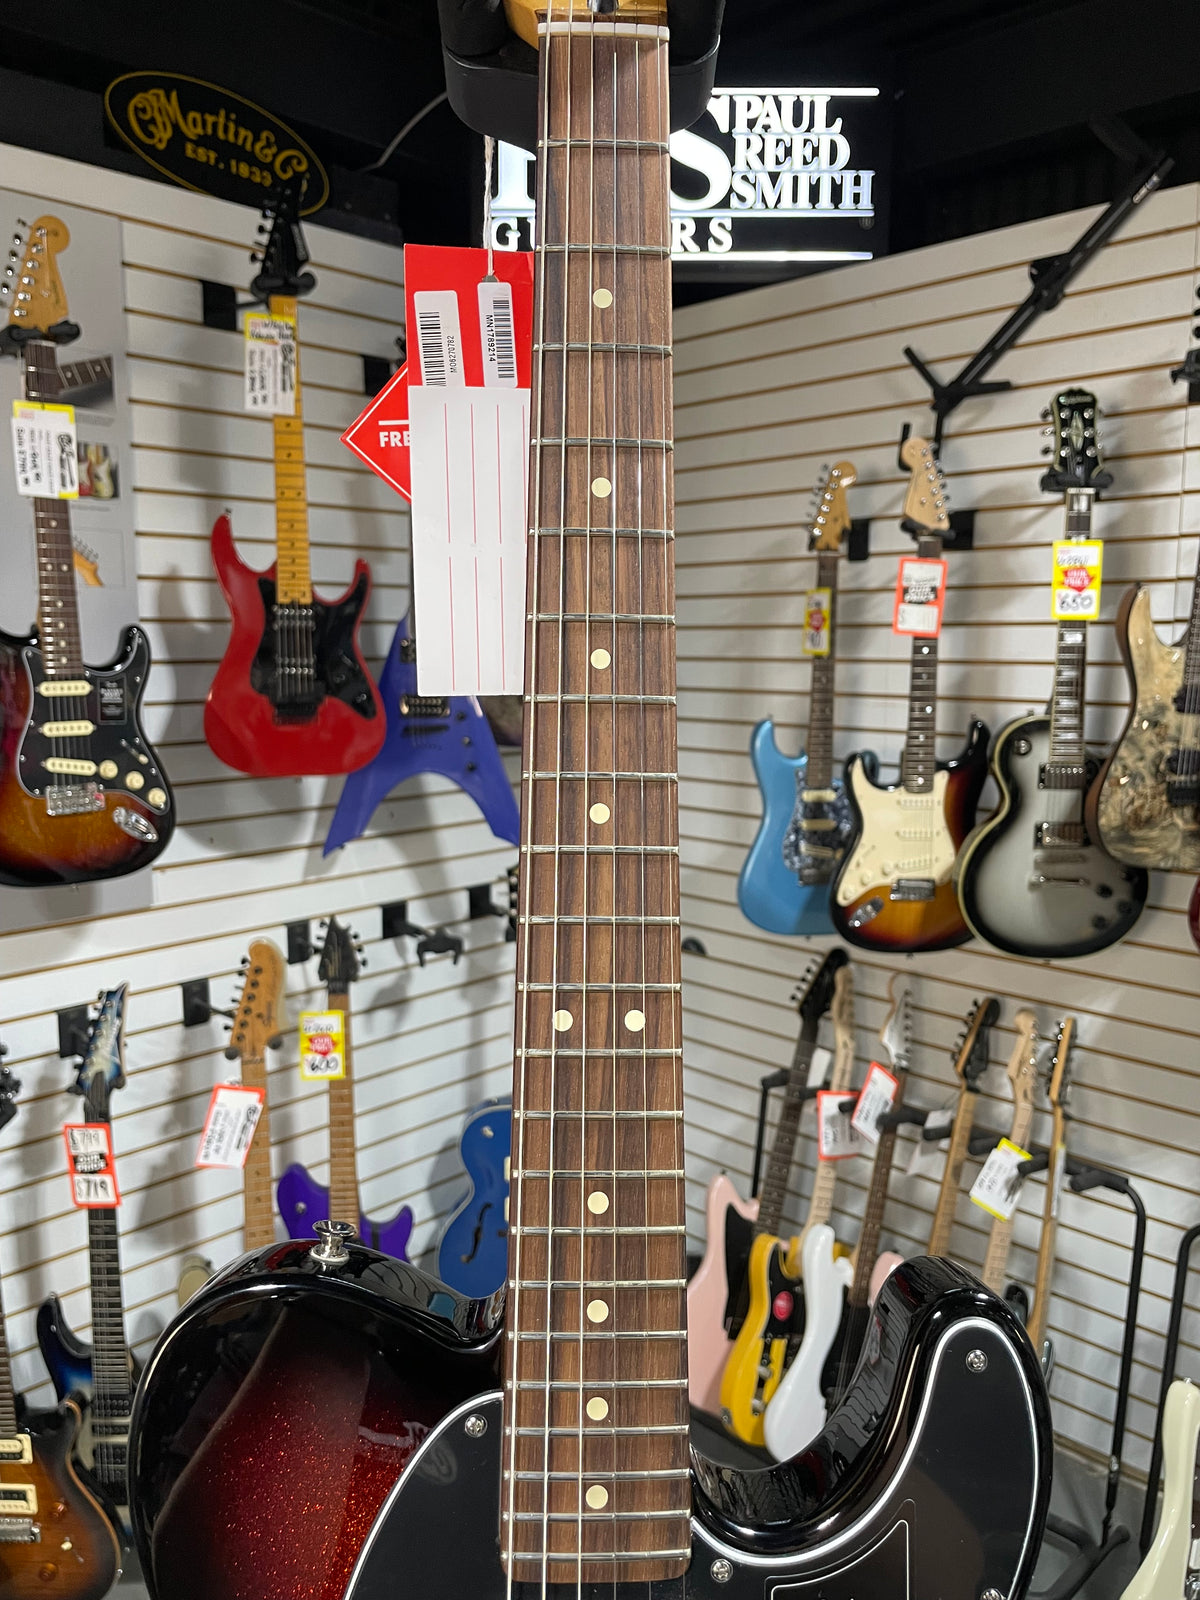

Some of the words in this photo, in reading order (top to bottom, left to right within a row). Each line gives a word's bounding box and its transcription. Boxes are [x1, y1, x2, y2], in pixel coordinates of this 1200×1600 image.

[732, 95, 843, 134] PAUL
[732, 134, 851, 172] REED
[730, 170, 876, 209] SMITH
[485, 314, 497, 363] MN1789214
[378, 430, 411, 448] FRE
